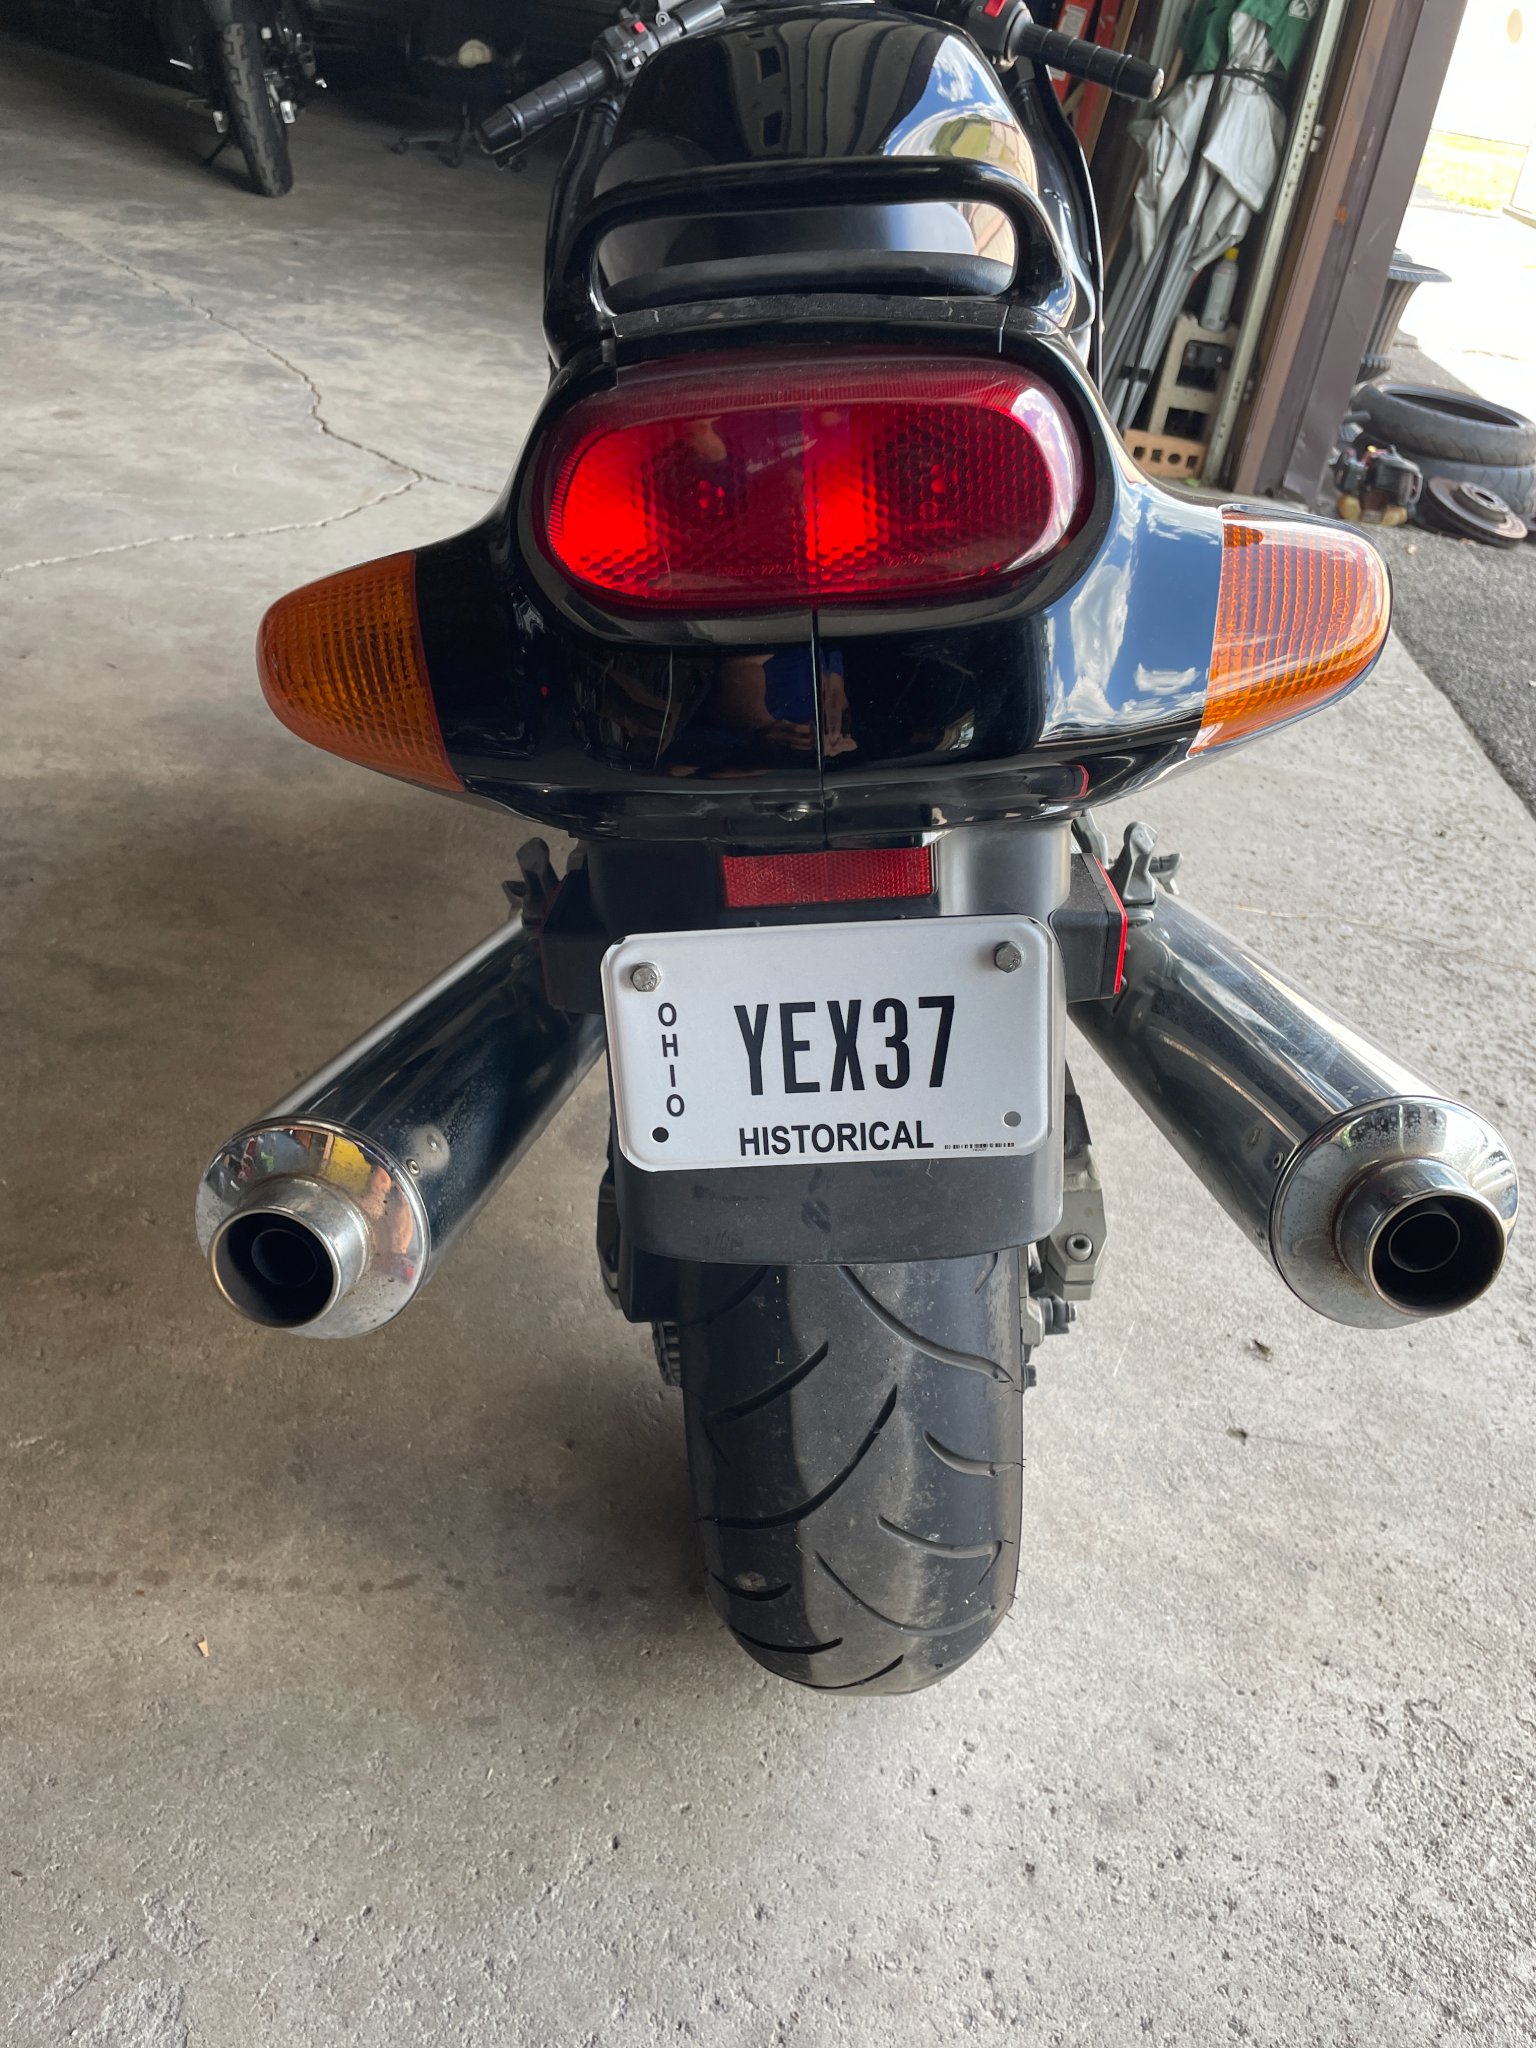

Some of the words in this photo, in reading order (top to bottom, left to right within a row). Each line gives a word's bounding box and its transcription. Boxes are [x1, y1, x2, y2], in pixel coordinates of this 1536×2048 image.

[657, 1002, 685, 1118] OHIO
[733, 995, 955, 1096] YEX37
[739, 1120, 935, 1157] HISTORICAL
